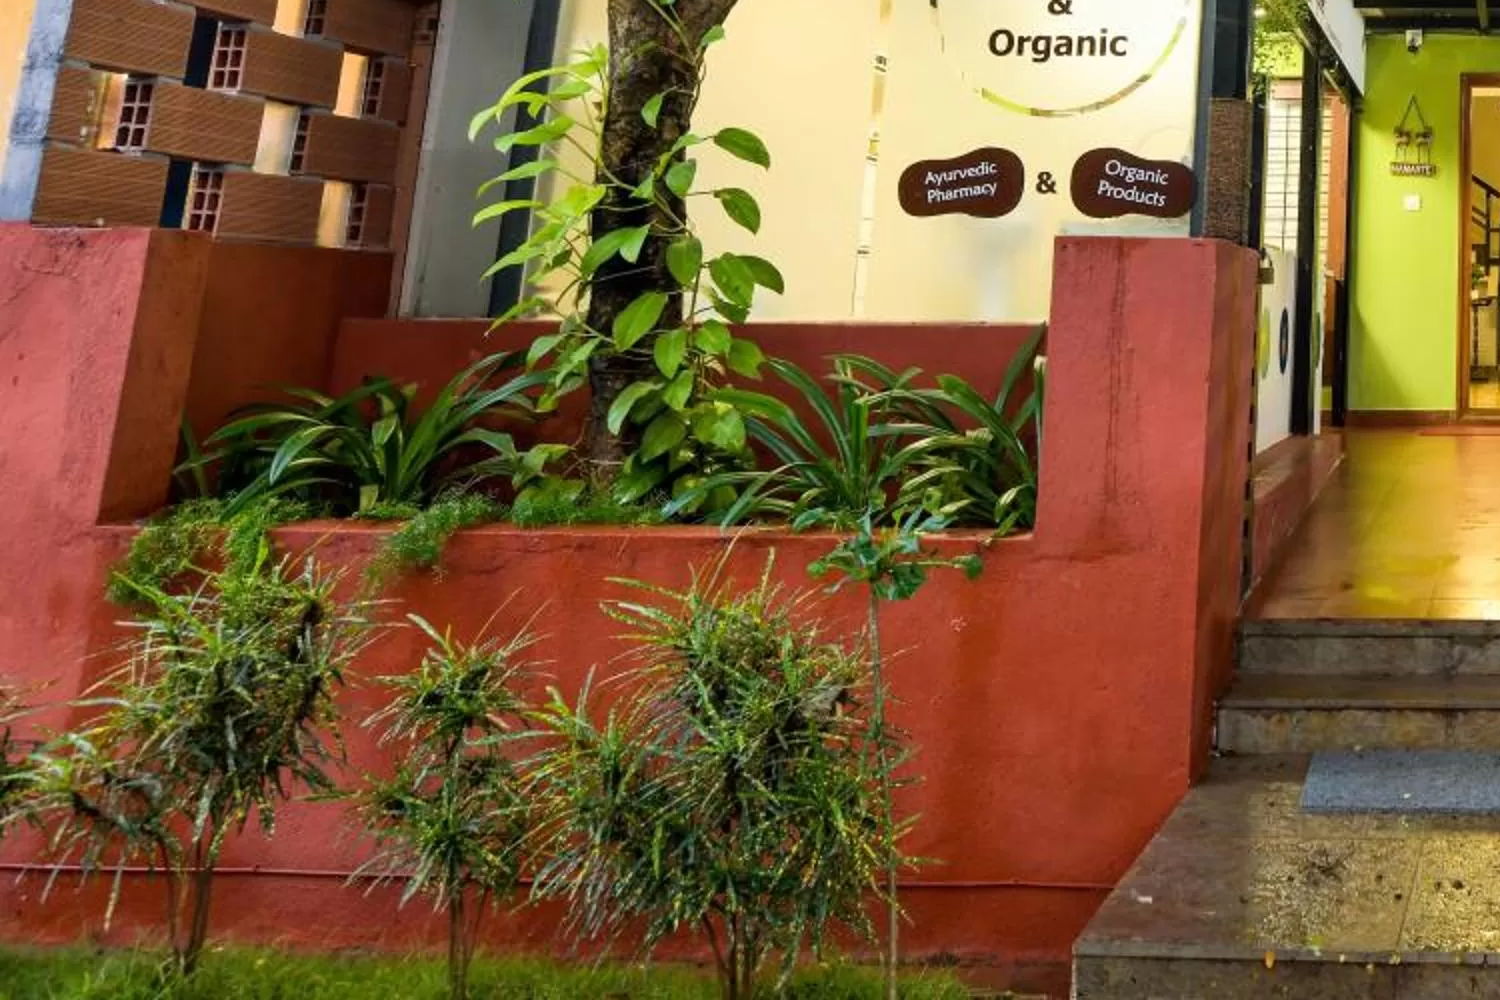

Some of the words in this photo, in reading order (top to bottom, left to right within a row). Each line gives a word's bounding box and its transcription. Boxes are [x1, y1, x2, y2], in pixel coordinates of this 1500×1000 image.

[988, 28, 1128, 62] Organic
[924, 161, 997, 186] Ayurvedic
[1036, 171, 1057, 194] &
[1105, 159, 1168, 185] Organic
[927, 182, 997, 203] Pharmacy
[1098, 181, 1166, 207] Products
